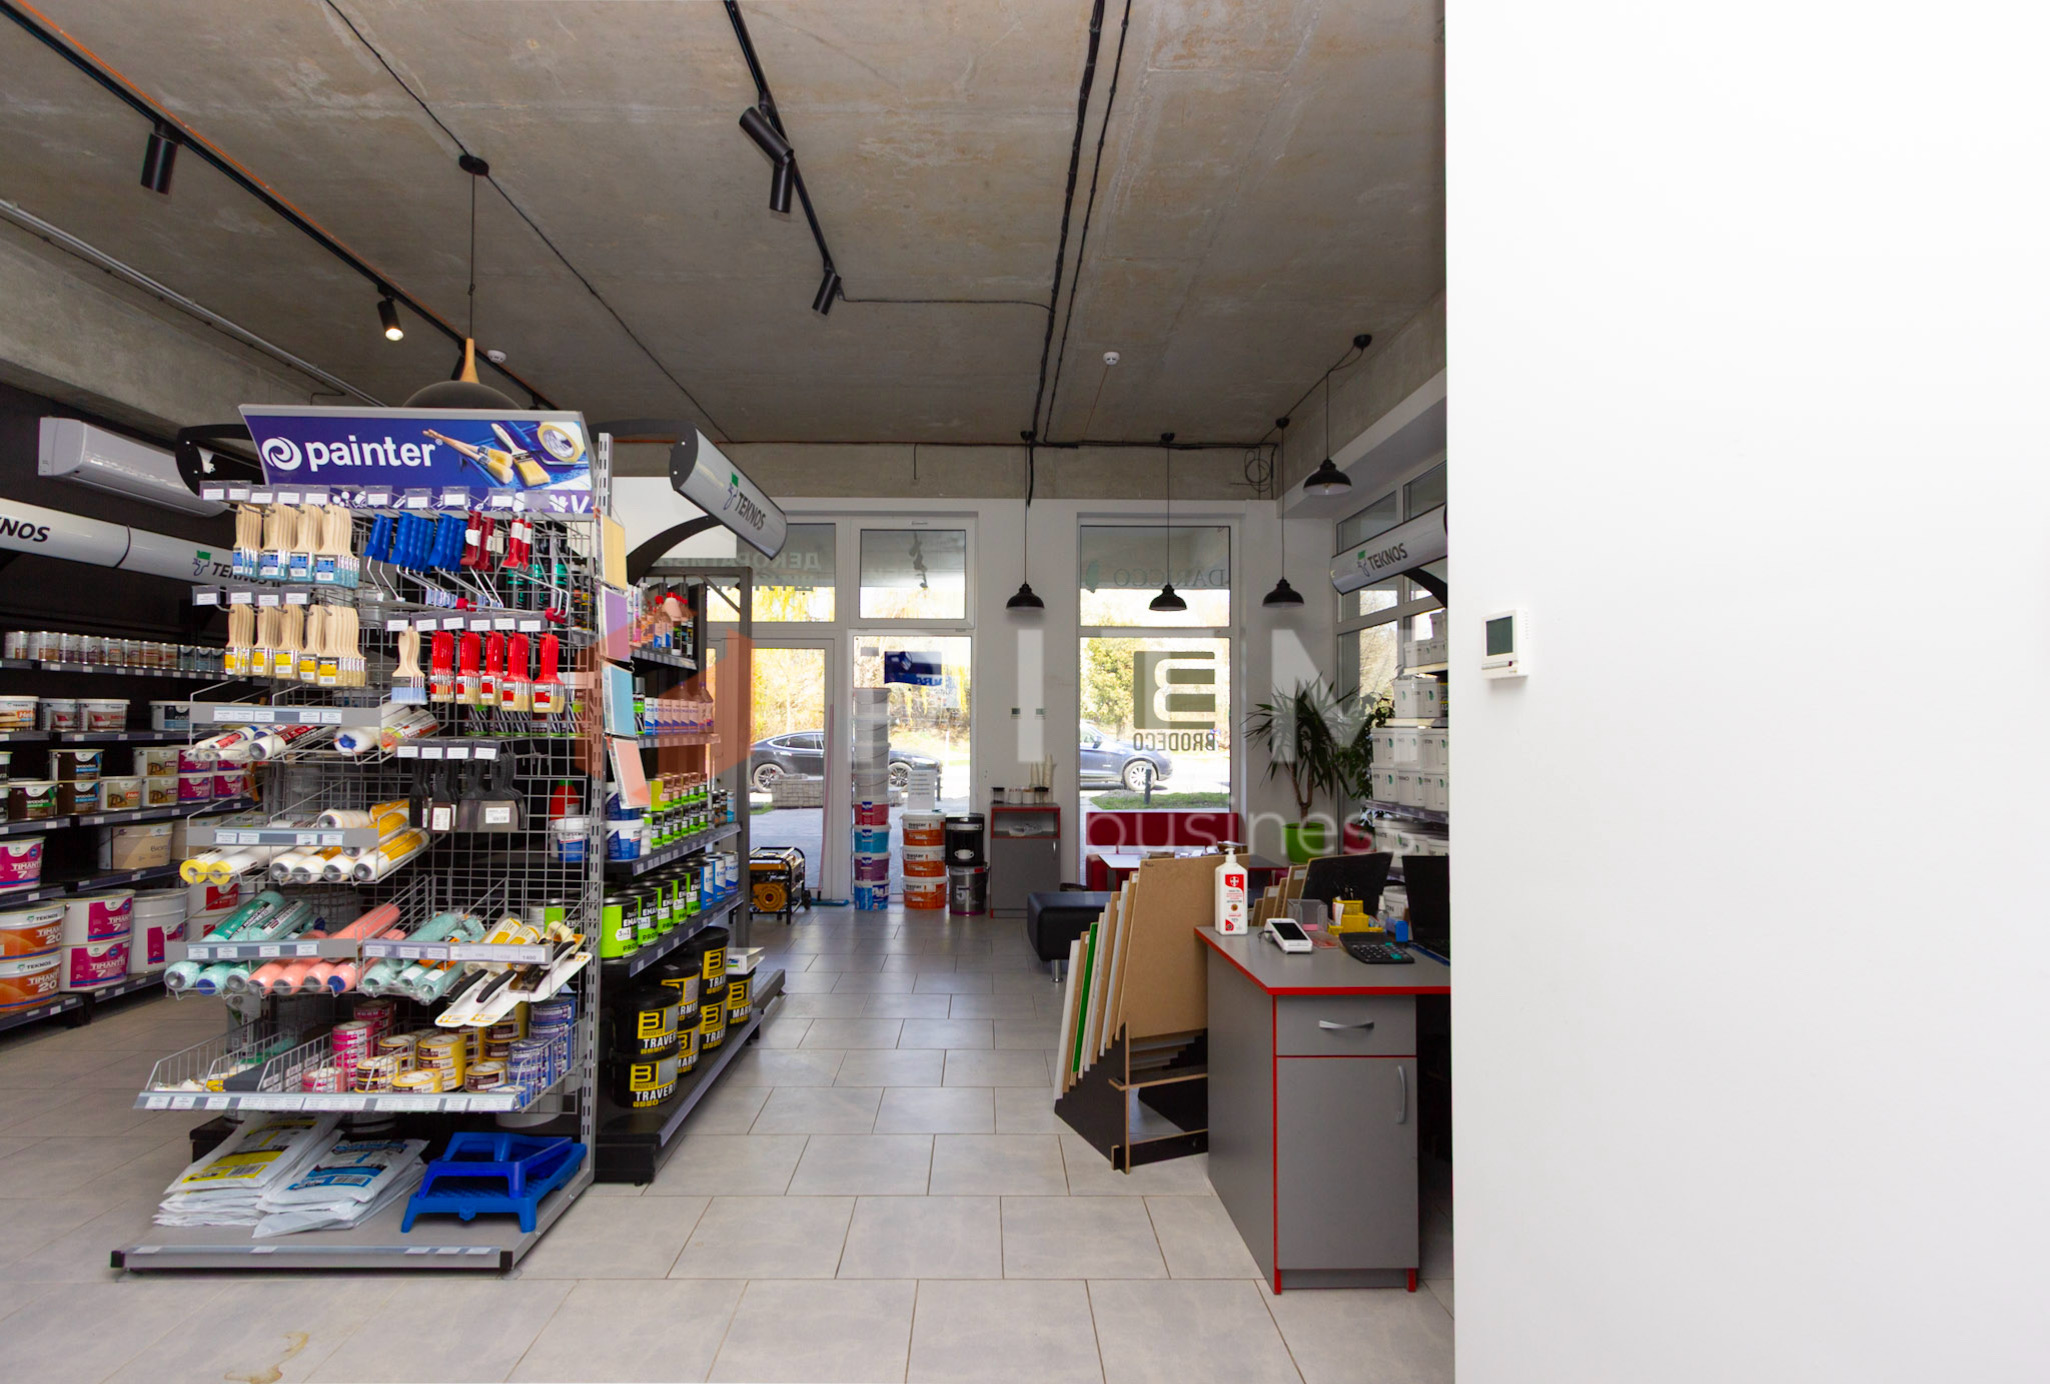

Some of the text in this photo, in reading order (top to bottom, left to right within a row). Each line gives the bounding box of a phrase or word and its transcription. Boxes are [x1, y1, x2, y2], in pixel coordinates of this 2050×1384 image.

[305, 435, 436, 472] painter
[735, 492, 767, 532] TEKNOS
[0, 517, 50, 543] NOS
[1368, 542, 1409, 572] TEKNOS
